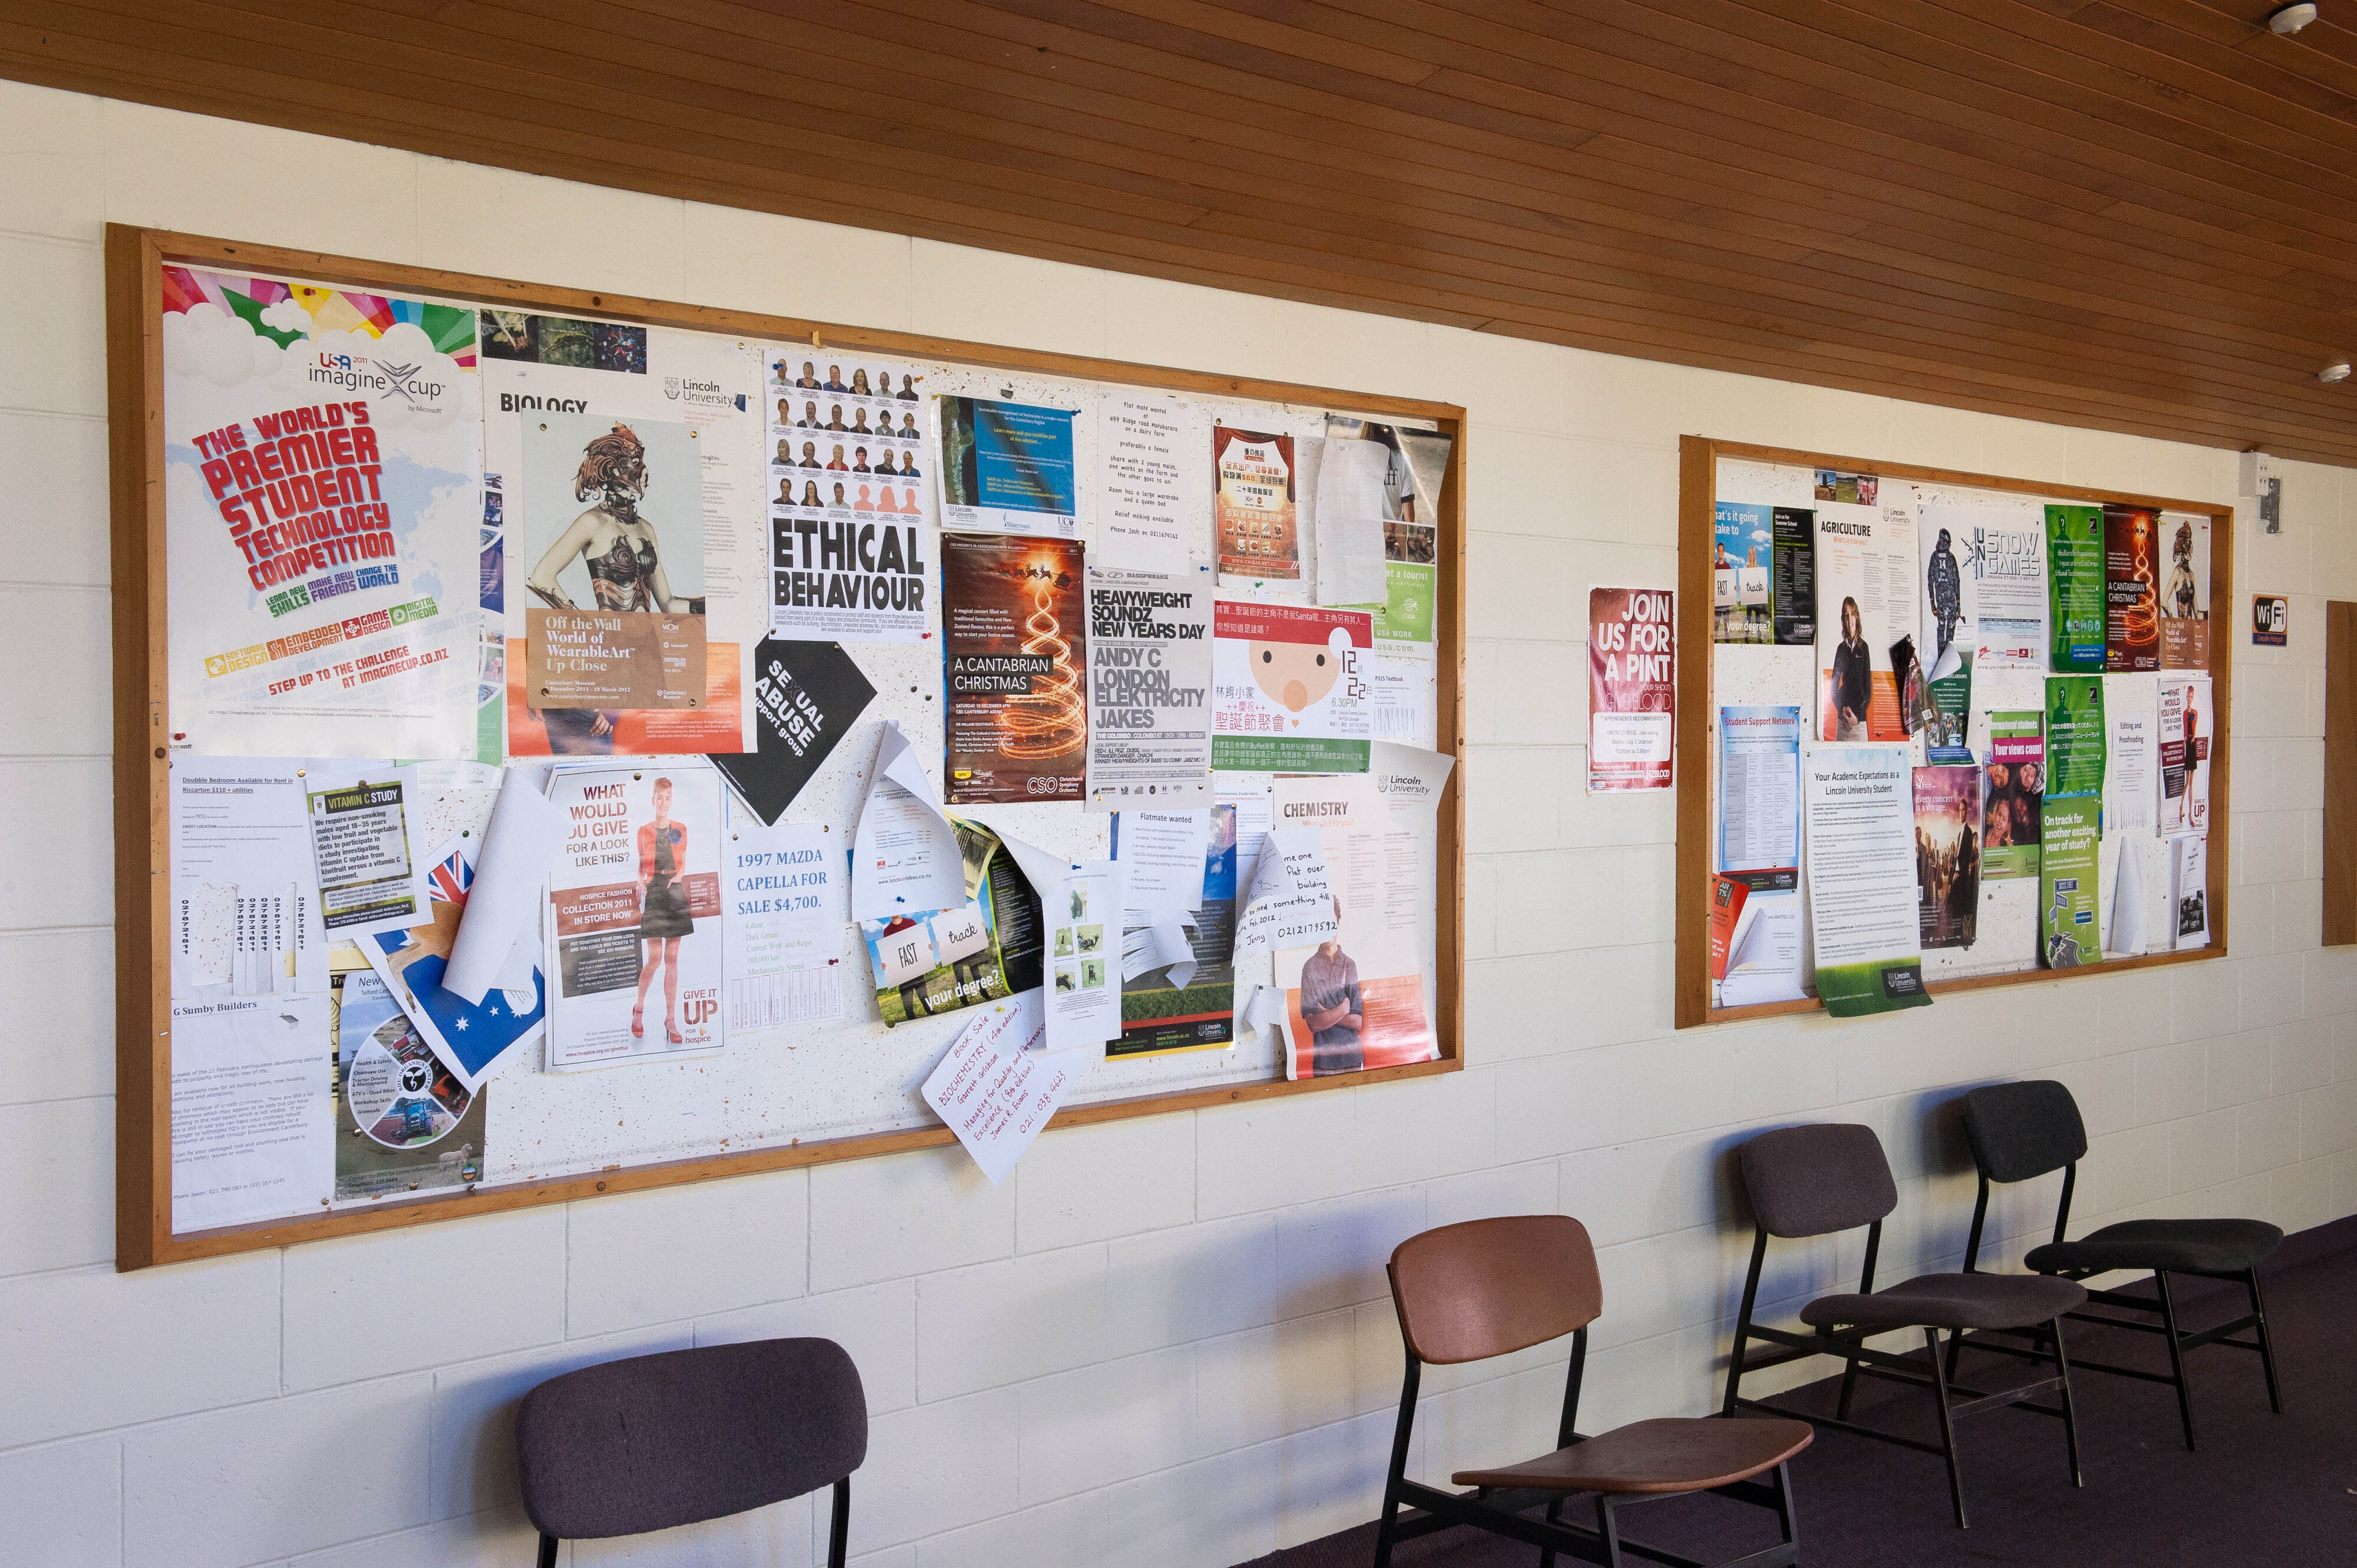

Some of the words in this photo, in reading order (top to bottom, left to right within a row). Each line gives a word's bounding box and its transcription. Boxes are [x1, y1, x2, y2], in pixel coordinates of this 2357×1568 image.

[320, 352, 351, 371] USA
[354, 356, 368, 365] 2011
[309, 364, 386, 391] imagine
[408, 379, 441, 400] cup
[683, 378, 720, 392] Lincoln
[683, 390, 733, 405] University
[192, 424, 247, 460] THE
[252, 401, 370, 440] WORLD'S
[200, 426, 381, 499] PREMIER
[219, 464, 383, 537] STUDENT
[1890, 515, 1910, 524] University
[234, 502, 391, 564] TECHNOLOGY
[1821, 521, 1871, 537] AGRICULTURE
[773, 517, 924, 575] ETHICAL
[1987, 530, 2039, 555] SNOW
[248, 532, 395, 591] COMPETITION
[1989, 555, 2040, 576] GAMES
[774, 570, 924, 612] BEHAVIOUR
[1717, 580, 1728, 596] FAST
[1746, 581, 1764, 592] track
[2108, 582, 2113, 590] A
[2114, 582, 2145, 592] CANTABRIAN
[1090, 589, 1192, 609] HEAVYWEIGHT
[2108, 593, 2137, 603] CHRISTMAS
[1092, 606, 1153, 623] SOUNDZ
[1622, 593, 1669, 623] JOIN
[546, 616, 567, 630] Off
[572, 619, 592, 630] the
[592, 618, 621, 631] Wall
[1093, 620, 1125, 638] NEW
[1128, 622, 1176, 639] YEARS
[1179, 625, 1205, 640] DAY
[1726, 622, 1743, 632] your
[1743, 620, 1771, 635] degree?
[546, 631, 586, 644] World
[591, 632, 604, 644] of
[1598, 623, 1625, 651] US
[1631, 624, 1670, 652] FOR
[954, 658, 964, 672] A
[967, 658, 1049, 672] CANTABRIAN
[1094, 647, 1144, 667] ANDY
[1148, 648, 1161, 668] C
[546, 659, 565, 674] Up
[569, 660, 607, 672] Close
[1604, 653, 1620, 681] A
[1627, 655, 1670, 682] PINT
[955, 676, 1027, 690] CHRISTMAS
[1095, 669, 1170, 688] LONDON
[1095, 684, 1205, 707] ELEKTRICITY
[1215, 686, 1254, 699] 林肯小家
[1331, 698, 1357, 708] 6.30PM
[755, 676, 815, 748] ABUSE
[1096, 709, 1155, 728] JAKES
[1215, 712, 1285, 732] 聖誕節聚會
[1725, 718, 1748, 726] Student
[1749, 718, 1771, 727] Support
[1772, 717, 1795, 725] Network
[2120, 722, 2132, 730] Editing
[778, 728, 804, 757] group
[2119, 735, 2144, 744] Proofreading
[1995, 744, 2008, 756] Your
[2009, 743, 2025, 755] views
[2025, 742, 2042, 754] count
[1390, 775, 1421, 785] Lincoln
[1815, 772, 1829, 781] Your
[1832, 772, 1858, 781] Academic
[1859, 771, 1888, 780] Expectations
[584, 784, 626, 800] WHAT
[1027, 776, 1057, 794] CSO
[1390, 784, 1430, 795] University
[1826, 786, 1846, 796] Lincoln
[1848, 786, 1872, 796] University
[1873, 784, 1892, 793] Student
[328, 795, 362, 809] VITAMIN
[364, 794, 370, 804] C
[371, 790, 398, 804] STUDY
[1916, 795, 1931, 804] Every
[1932, 795, 1953, 803] concert
[569, 802, 628, 820] WOULD
[1284, 801, 1349, 817] CHEMISTRY
[1926, 804, 1947, 813] voyage.
[2194, 805, 2205, 818] UP
[325, 816, 347, 826] require
[348, 811, 386, 822] non-smoking
[1140, 813, 1166, 823] Flatmate
[1169, 815, 1192, 824] wanted
[2045, 815, 2054, 826] On
[2055, 815, 2072, 824] track
[2073, 813, 2084, 824] for
[592, 820, 628, 837] GIVE
[2045, 827, 2071, 839] another
[2072, 826, 2096, 838] exciting
[566, 841, 588, 854] FOR
[591, 841, 598, 851] A
[599, 838, 629, 850] LOOK
[2045, 841, 2060, 854] year
[2061, 840, 2068, 851] of
[2069, 837, 2091, 850] study?
[575, 856, 598, 867] LIKE
[601, 852, 630, 864] THIS?
[737, 853, 772, 868] 1997
[777, 849, 822, 865] MAZDA
[738, 874, 798, 891] CAPELLA
[801, 872, 828, 886] FOR
[878, 873, 932, 884] www.backonbikes.co.nz
[1297, 880, 1327, 889] building
[738, 899, 771, 915] SALE
[774, 895, 822, 913] $4,700.
[1274, 897, 1316, 908] something
[898, 942, 918, 969] FAST
[948, 923, 978, 944] track
[925, 985, 953, 1011] your
[955, 969, 1000, 998] degree?
[173, 1008, 180, 1016] G
[183, 1005, 215, 1017] Sumby
[217, 1001, 258, 1012] Builders
[684, 999, 718, 1025] UP
[685, 1034, 711, 1045] hospice
[566, 1045, 628, 1058] www.hospice.org.nz/giveitup
